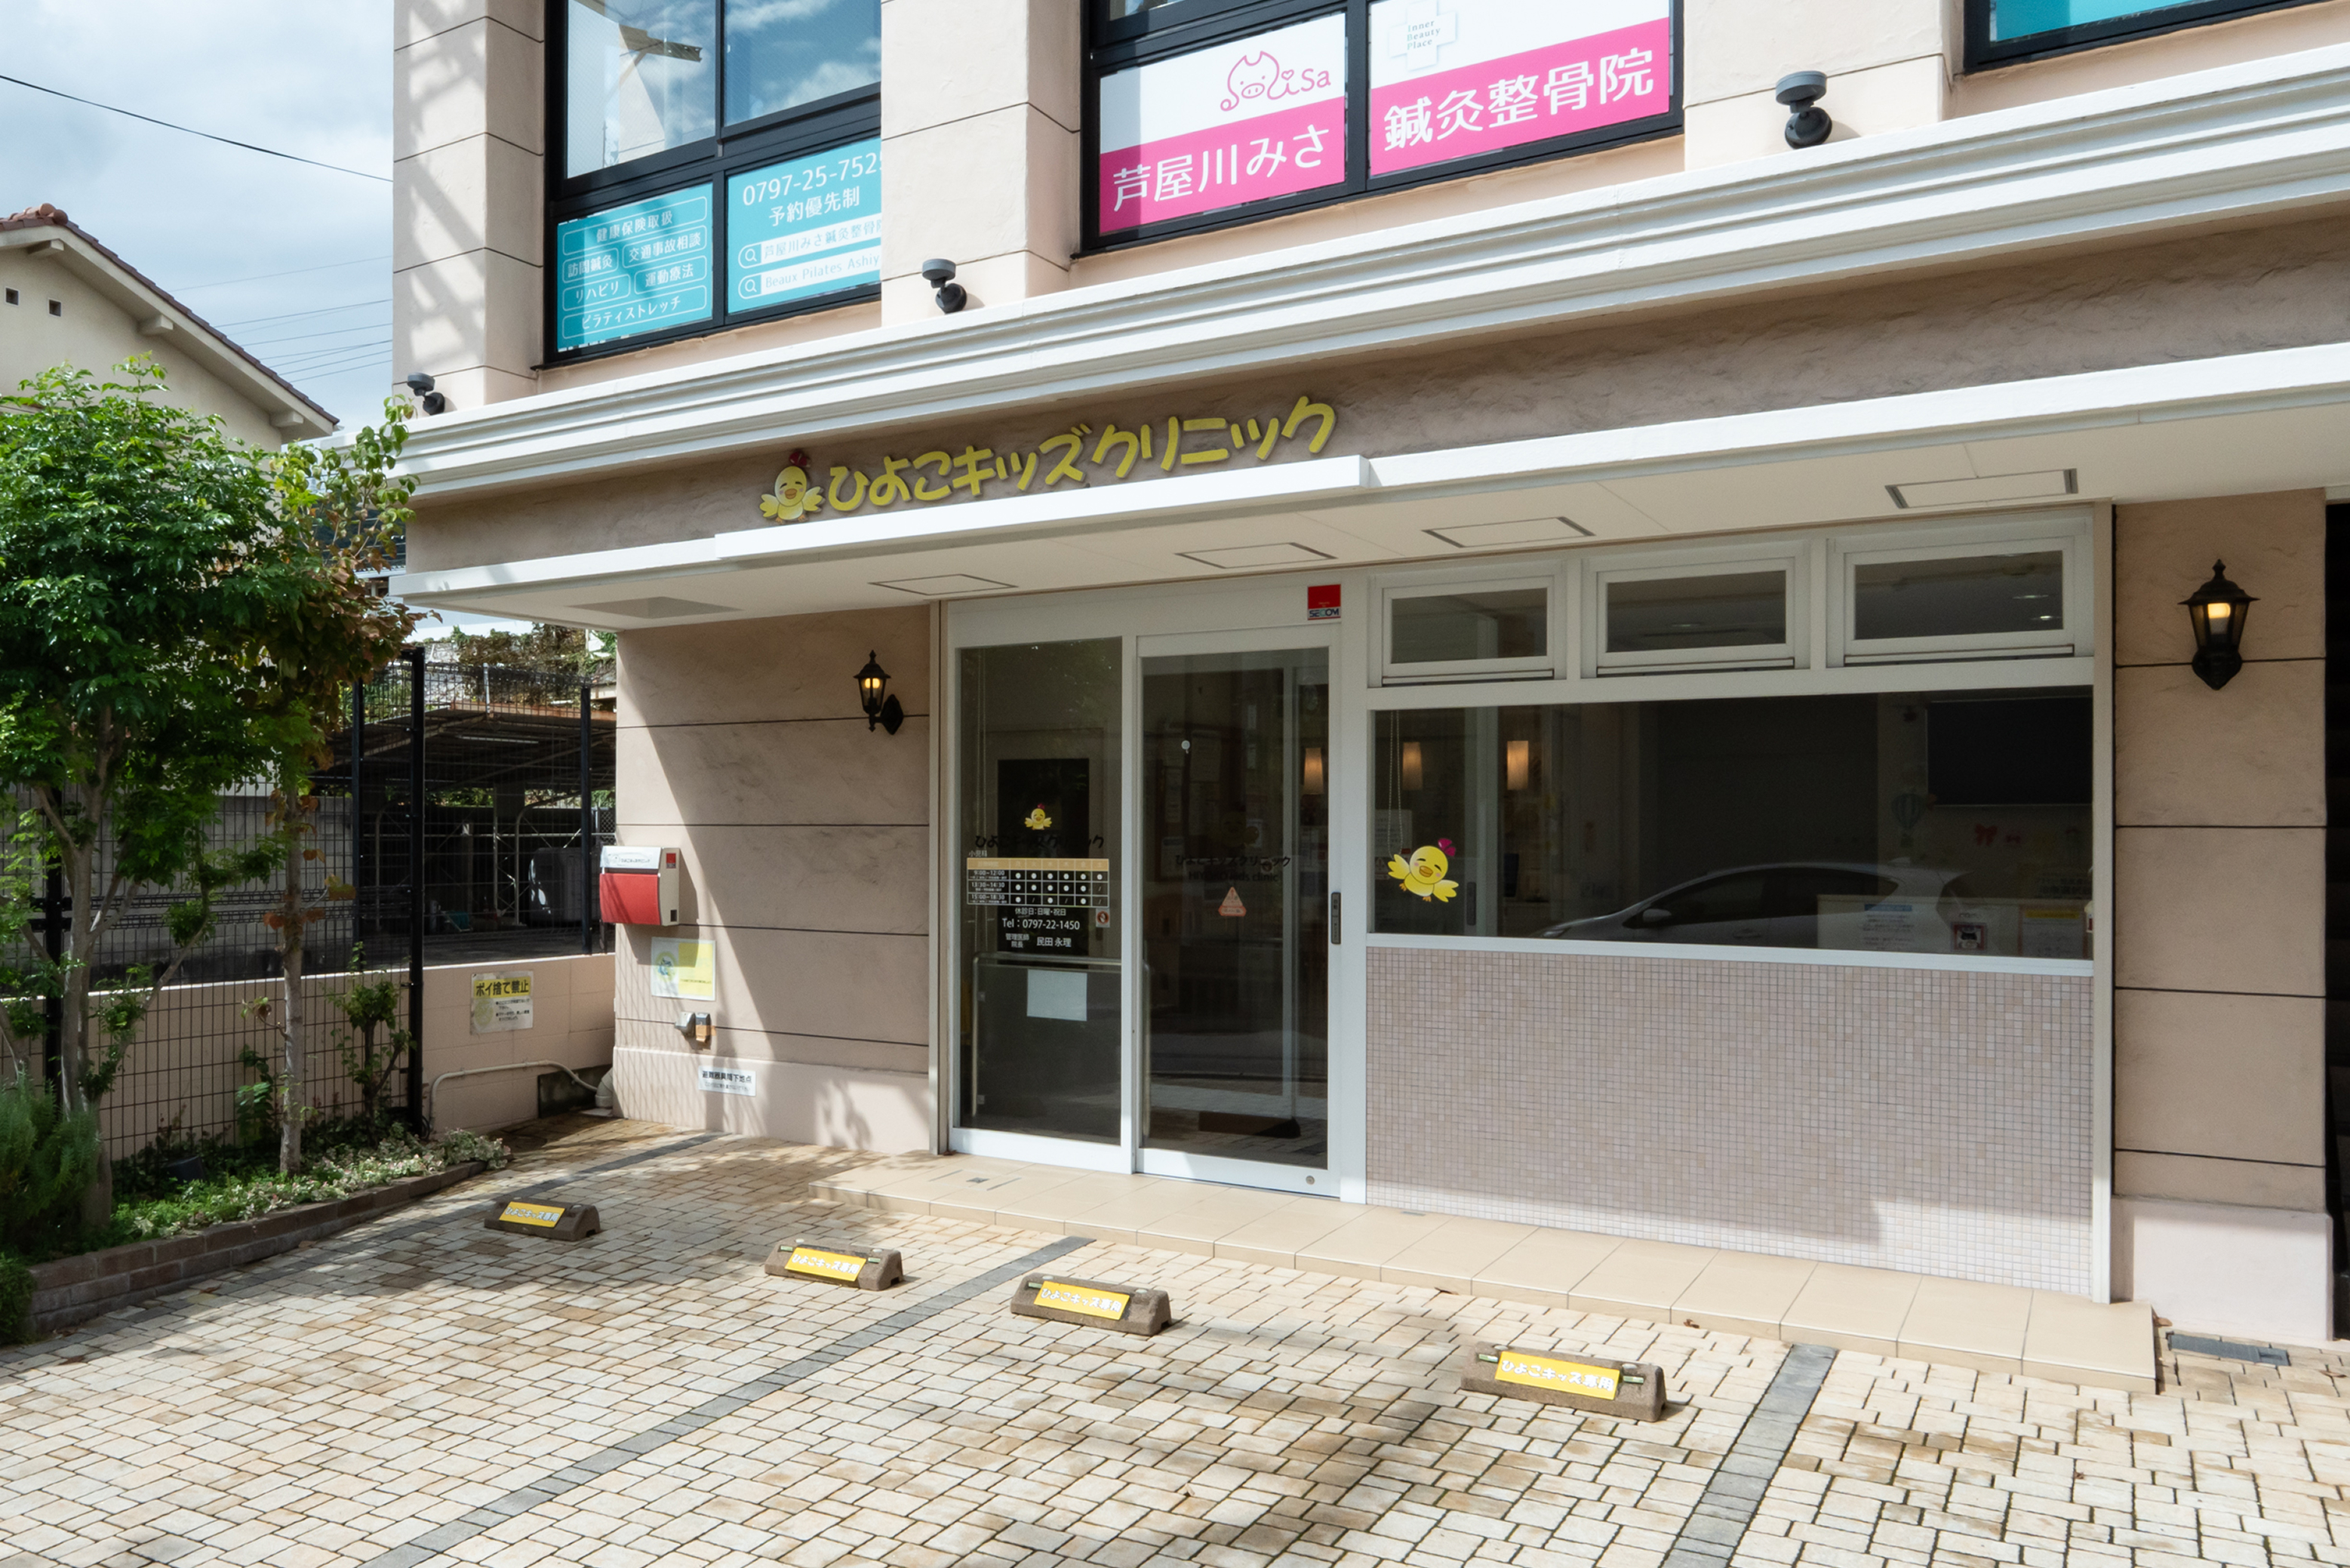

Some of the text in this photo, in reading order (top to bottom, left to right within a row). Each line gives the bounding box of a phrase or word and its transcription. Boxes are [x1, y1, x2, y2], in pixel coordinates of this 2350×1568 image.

[1407, 20, 1435, 32] Inner
[1407, 28, 1441, 42] Beauty
[1407, 38, 1432, 50] Place
[1383, 47, 1653, 151] 鍼灸整骨院
[743, 152, 881, 206] 0797-25-752
[1112, 124, 1330, 212] 芦屋川みさ
[769, 186, 860, 226] 予約優先制
[596, 210, 673, 243] 健康保険取扱
[568, 232, 702, 278] 訪問鍼灸 交通事故相談
[576, 263, 694, 303] リハビリ 運動療法
[765, 273, 798, 288] Beaux
[802, 263, 842, 280] Pilates
[828, 395, 1336, 512] ひよこキッズクリニック
[1309, 607, 1340, 618] SECOM
[1023, 919, 1080, 930] 0797-22-1450
[476, 979, 529, 996] ポイ捨て禁止
